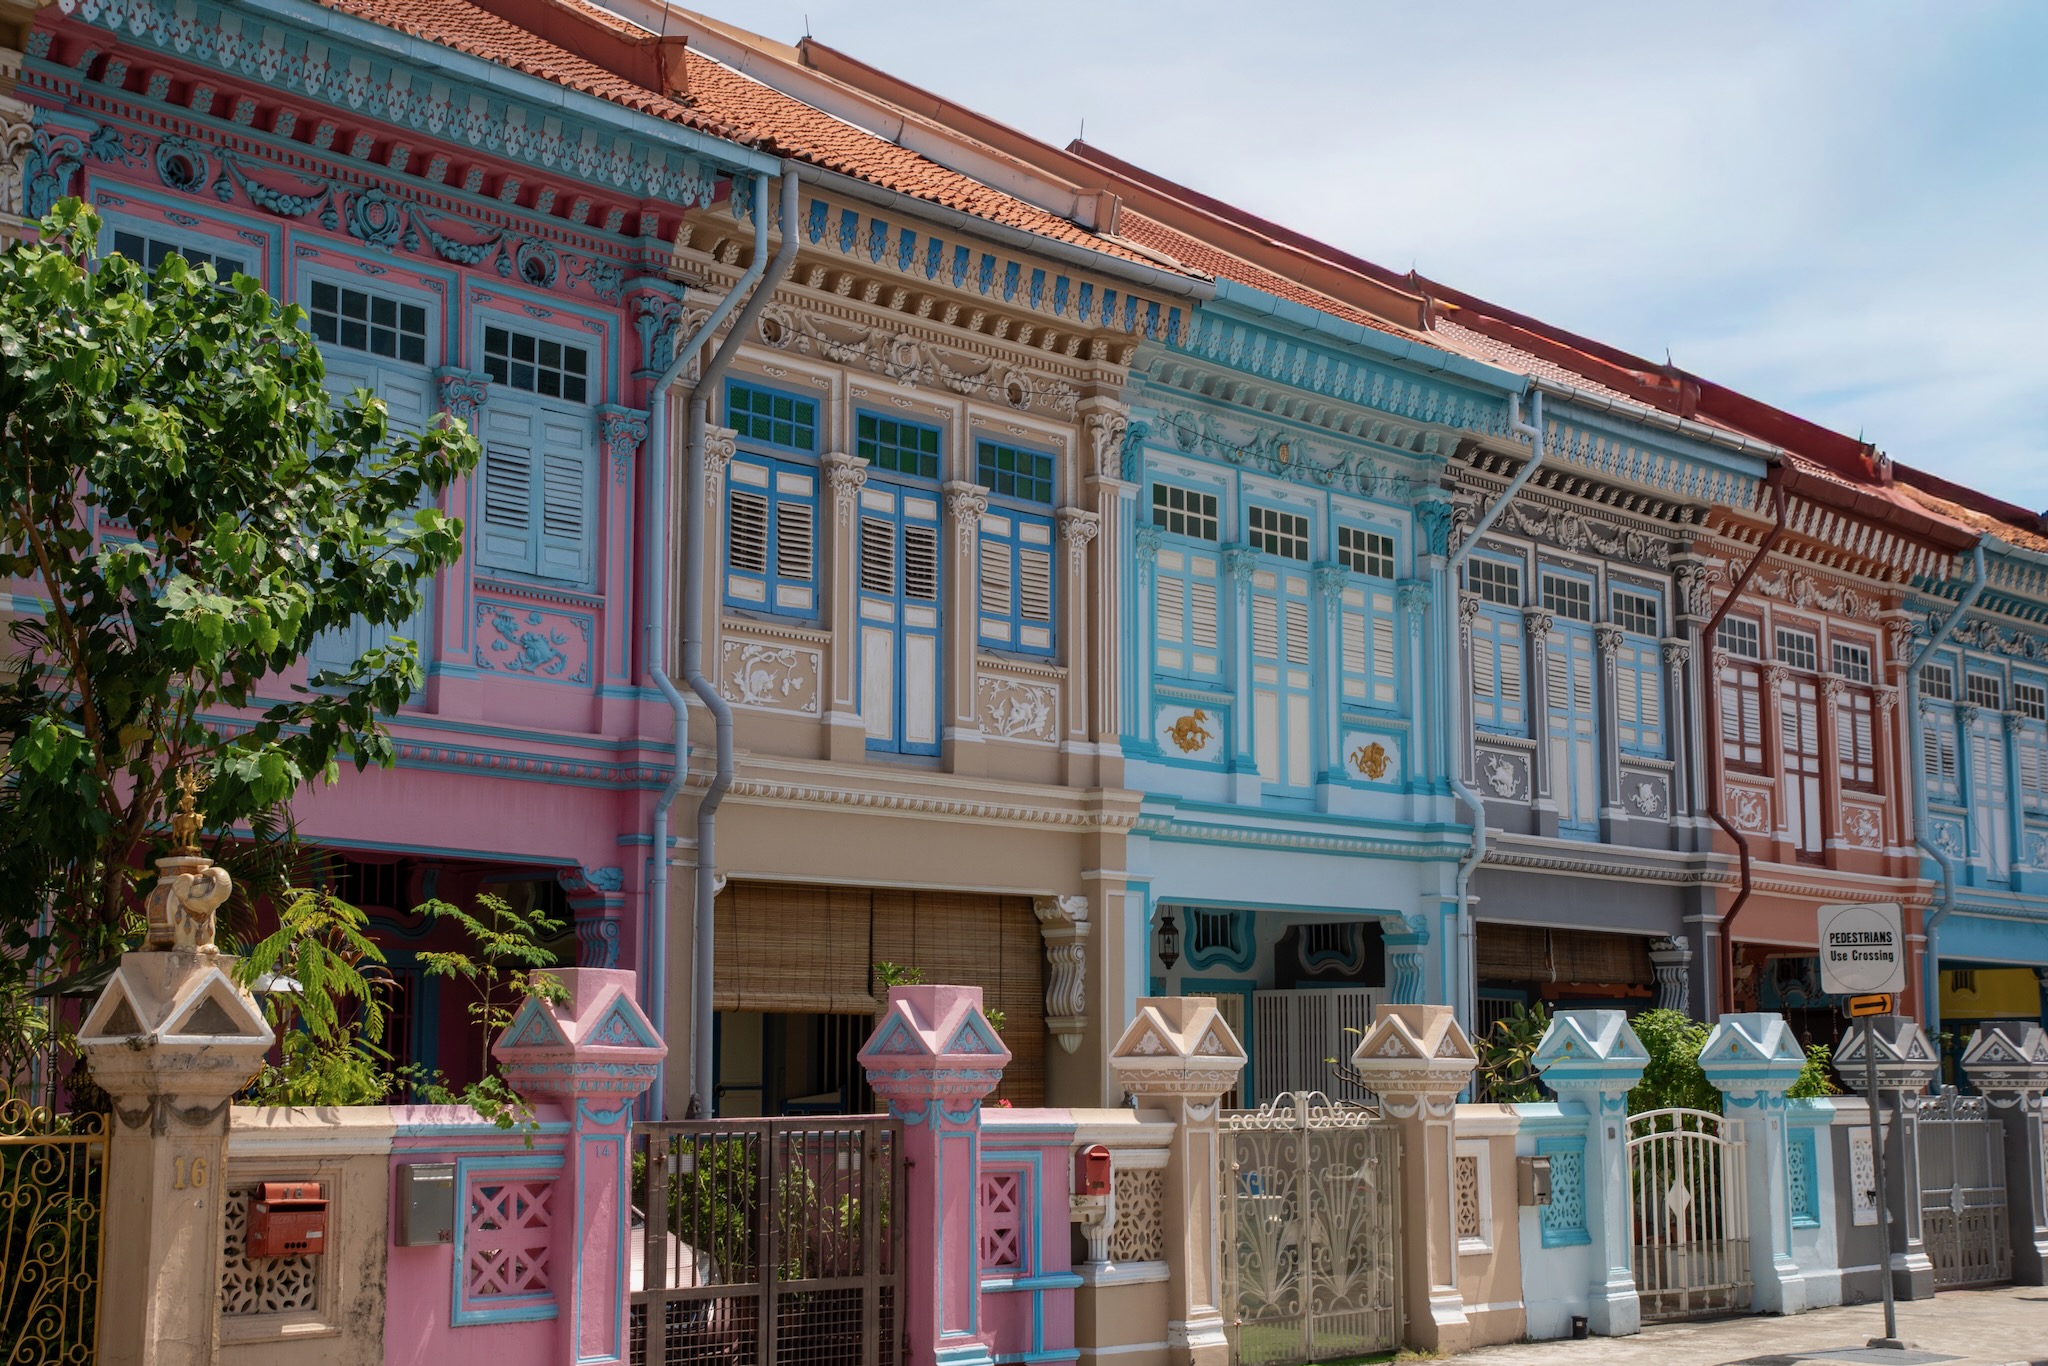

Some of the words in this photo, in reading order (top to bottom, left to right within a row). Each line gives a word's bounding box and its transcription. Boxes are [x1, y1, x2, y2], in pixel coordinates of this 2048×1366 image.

[1829, 931, 1893, 944] PEDESTRIANS
[1830, 950, 1848, 962] Use
[1852, 949, 1894, 963] Crossing
[595, 1144, 611, 1158] 14
[174, 1156, 208, 1189] 16
